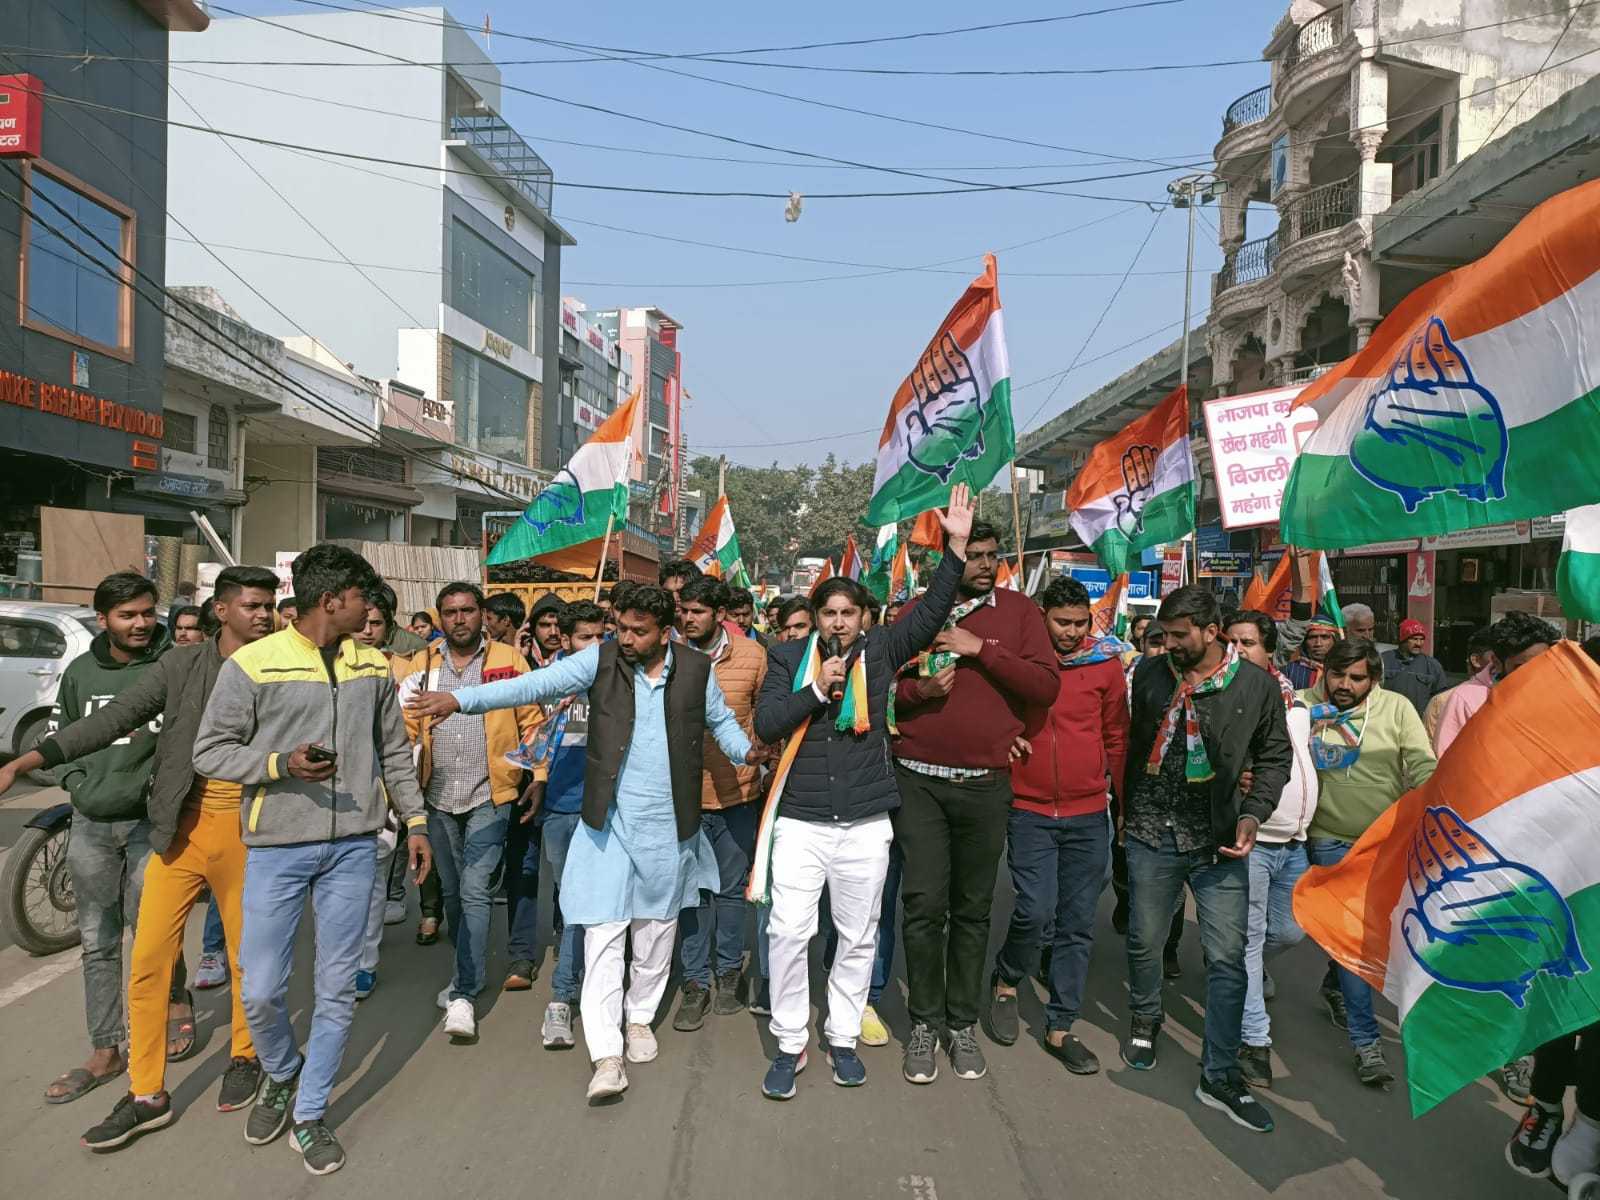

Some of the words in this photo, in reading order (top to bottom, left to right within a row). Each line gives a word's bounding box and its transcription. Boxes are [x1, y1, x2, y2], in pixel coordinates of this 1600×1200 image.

[40, 382, 96, 423] BIHARI
[99, 399, 164, 439] PLYWOOD
[1217, 402, 1270, 423] भाजपा
[1249, 422, 1287, 448] महंगी
[1227, 456, 1290, 486] बिजली
[503, 473, 549, 497] PLYWOO
[1230, 492, 1271, 513] महंगा
[1081, 581, 1108, 593] करण
